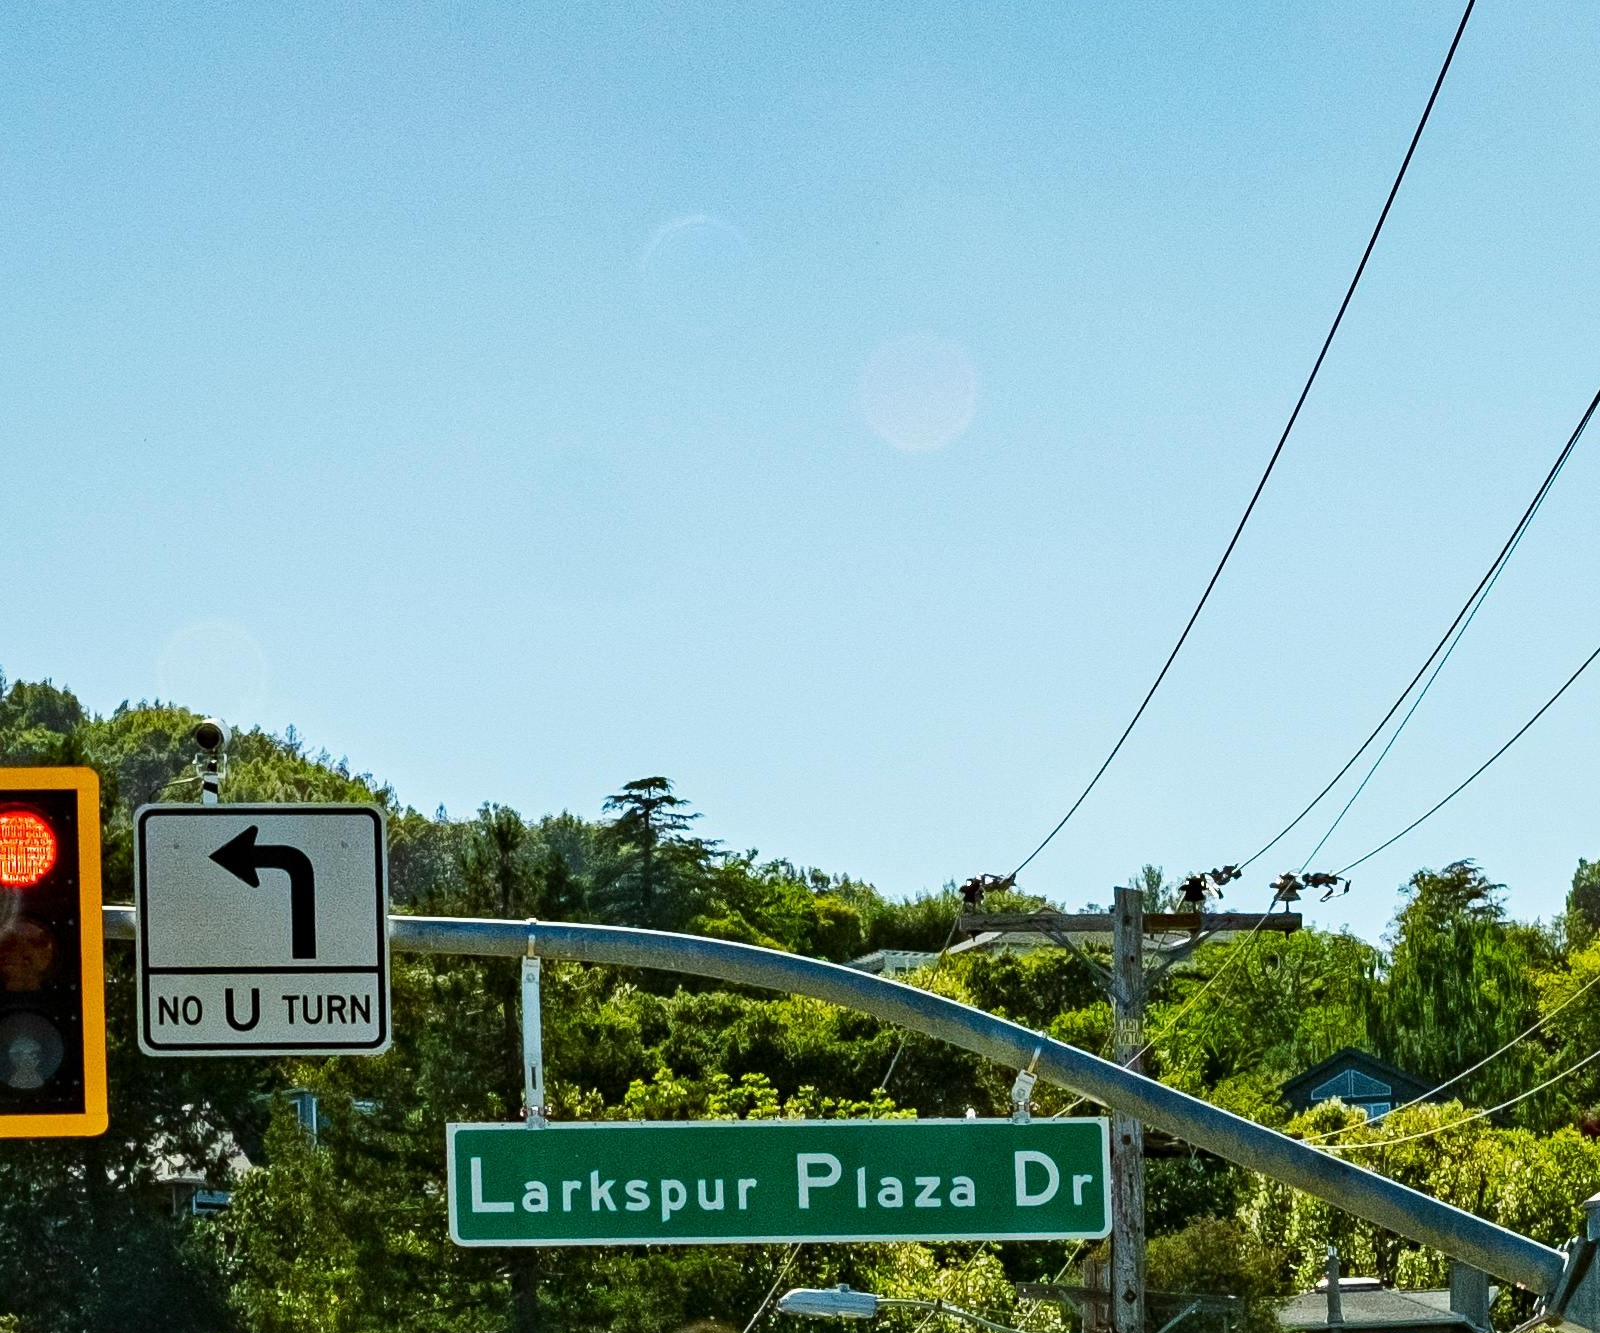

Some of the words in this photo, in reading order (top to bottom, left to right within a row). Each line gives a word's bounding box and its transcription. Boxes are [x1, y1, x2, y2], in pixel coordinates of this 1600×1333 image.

[158, 996, 203, 1025] NO
[225, 988, 260, 1032] U
[282, 995, 371, 1024] TURN
[471, 1157, 757, 1222] Larkspur
[797, 1152, 976, 1210] Plaza
[1014, 1151, 1093, 1207] Dr
